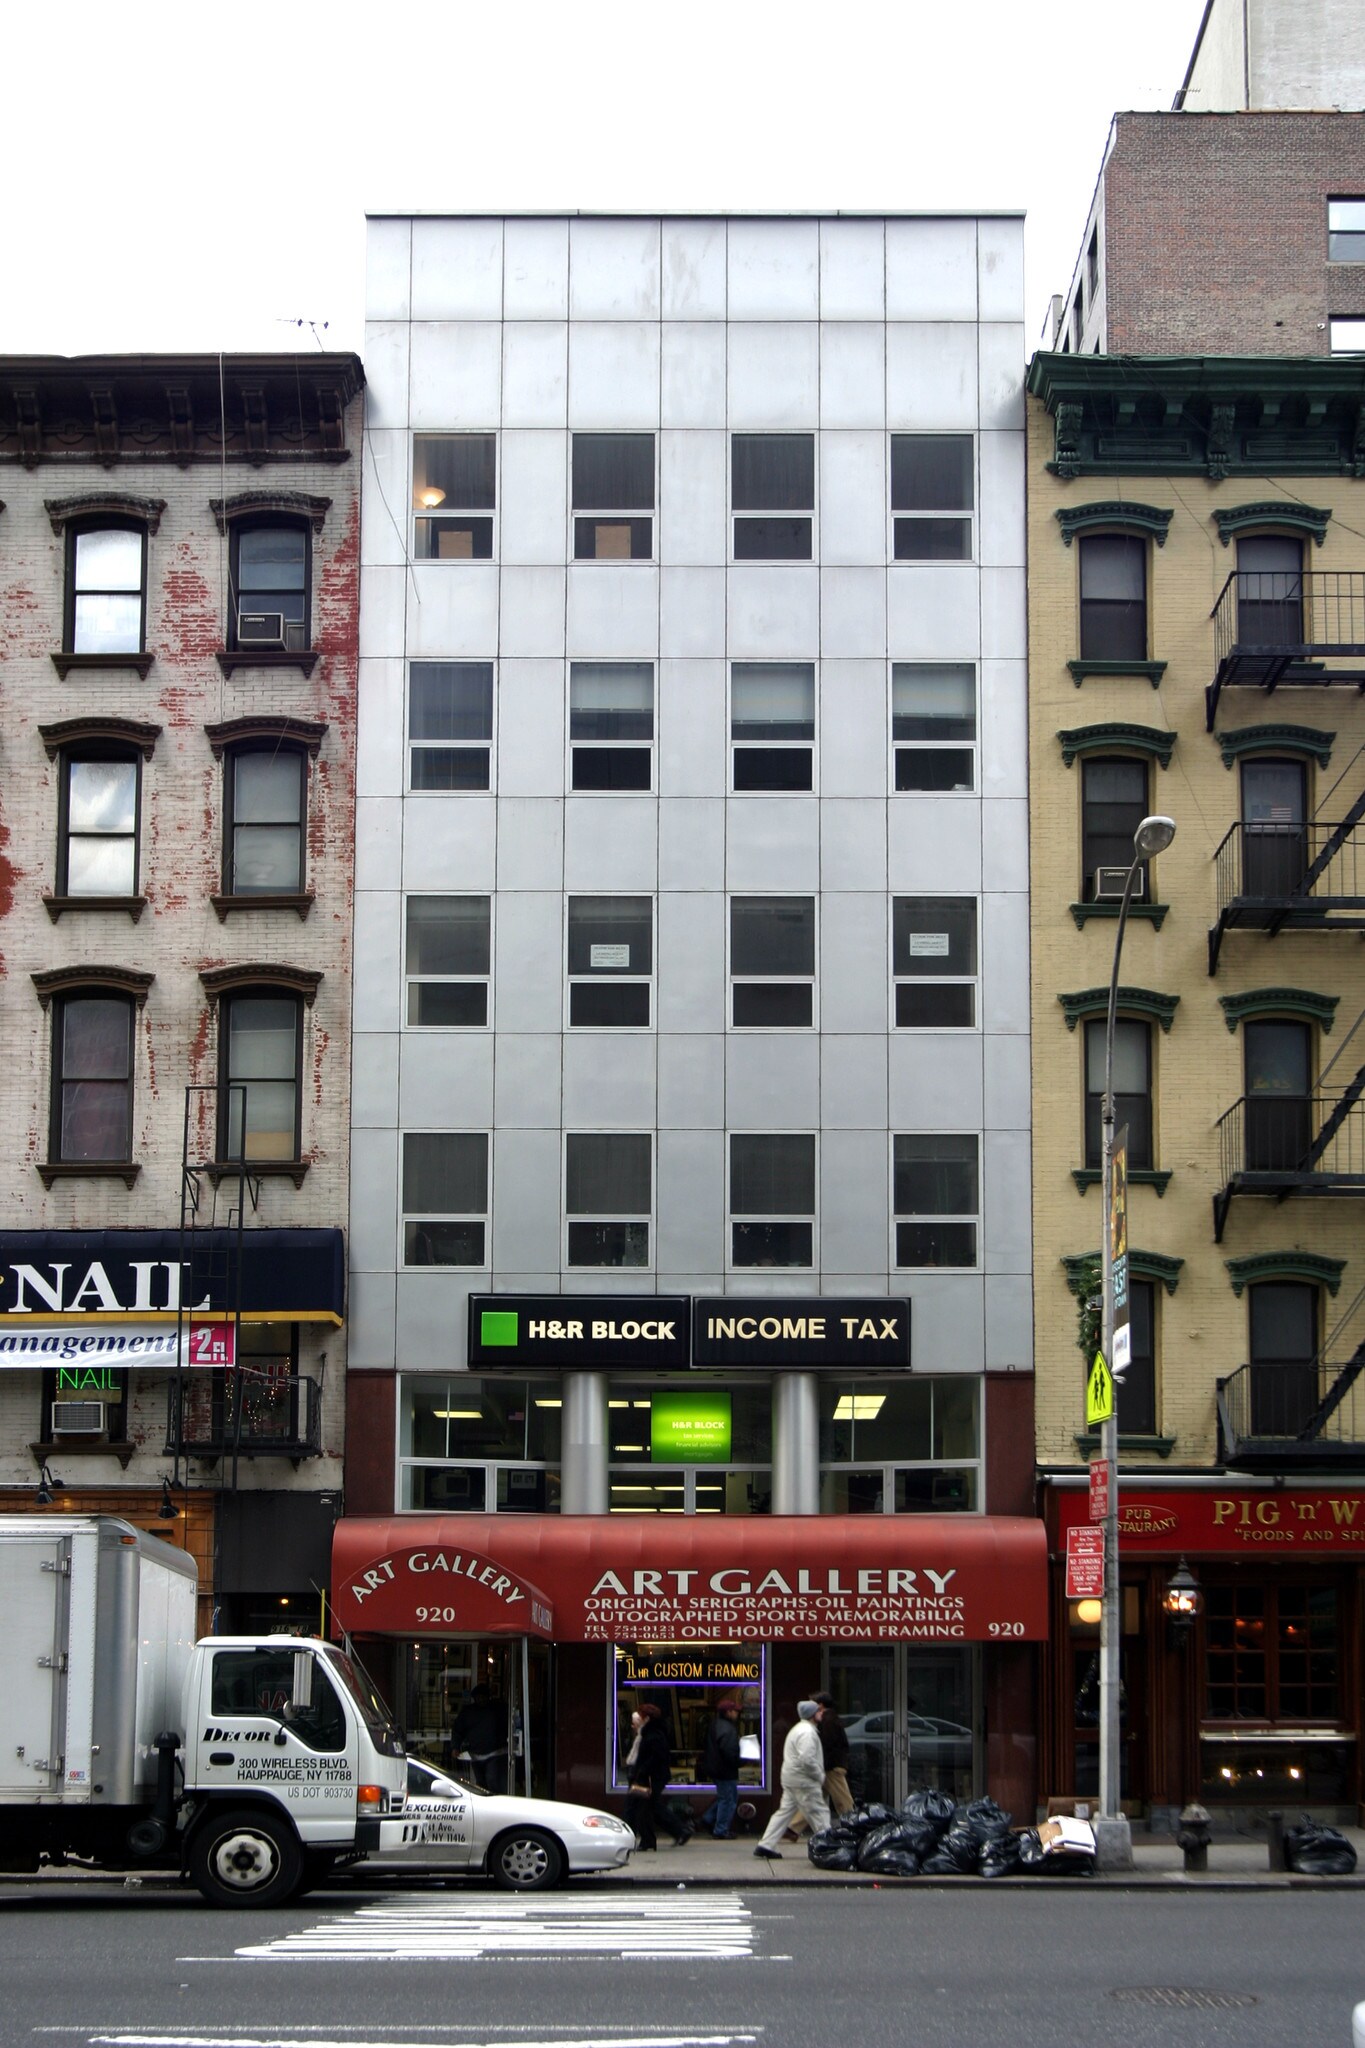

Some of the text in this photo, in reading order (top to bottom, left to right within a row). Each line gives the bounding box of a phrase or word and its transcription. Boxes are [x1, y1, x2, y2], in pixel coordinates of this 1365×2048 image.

[8, 1261, 211, 1312] NAIL
[528, 1321, 676, 1340] H&R BLOCK
[708, 1317, 899, 1340] INCOME TAX
[59, 1368, 121, 1390] NAIL
[671, 1421, 725, 1429] H&R BLOCK
[1125, 1508, 1152, 1520] PUB
[1212, 1500, 1281, 1525] PIG
[1328, 1500, 1365, 1525] W
[1302, 1529, 1334, 1541] AND
[351, 1552, 526, 1605] ART GALLERY
[590, 1569, 957, 1595] ART GALLERY
[584, 1597, 682, 1610] ORIGINAL
[815, 1596, 849, 1608] OIL
[857, 1596, 964, 1608] PAINTINGS
[415, 1606, 456, 1622] 920
[585, 1609, 964, 1622] AUTOGRAPHED SPORTS MEMORABILIA
[681, 1625, 964, 1637] ONE HOUR CUSTOM FRAMING
[988, 1621, 1025, 1636] 920
[654, 1662, 703, 1678] CUSTOM
[707, 1663, 759, 1679] FRAMING
[238, 1758, 349, 1769] 300 WIRELESS BLVD.
[237, 1770, 352, 1782] HAUPPAUGE, NY 11788
[287, 1787, 353, 1798] US DOT 903730
[406, 1804, 466, 1813] EXCLUSIVE
[437, 1823, 455, 1832] Ave.
[432, 1833, 466, 1843] NY 11416
